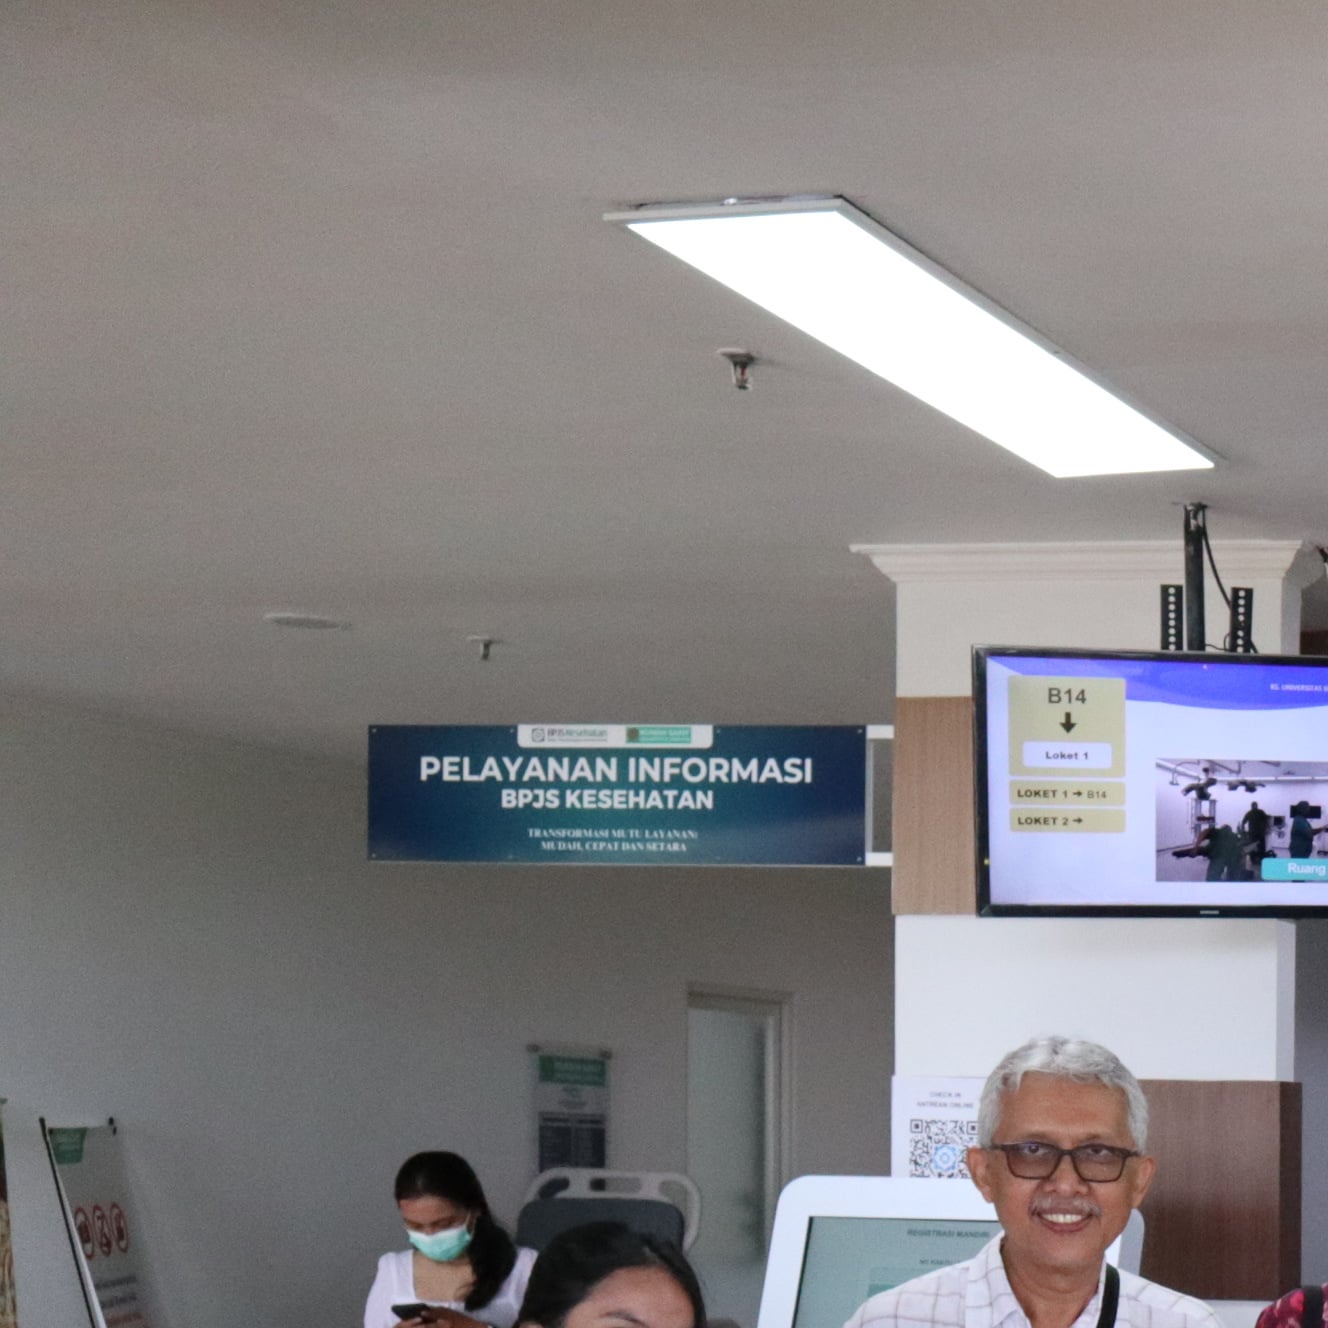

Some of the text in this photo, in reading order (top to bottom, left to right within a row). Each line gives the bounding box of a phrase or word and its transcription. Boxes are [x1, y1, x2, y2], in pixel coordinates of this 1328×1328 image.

[1048, 687, 1087, 704] B14
[1045, 751, 1078, 760] Loket
[420, 756, 813, 783] PELAYANAN INFORMASI
[501, 789, 714, 810] BPJS KESEHATAN
[1017, 789, 1058, 798] LOKET
[1087, 790, 1107, 799] B14
[1018, 816, 1068, 825] LOKET 2
[1287, 862, 1326, 876] Ruang
